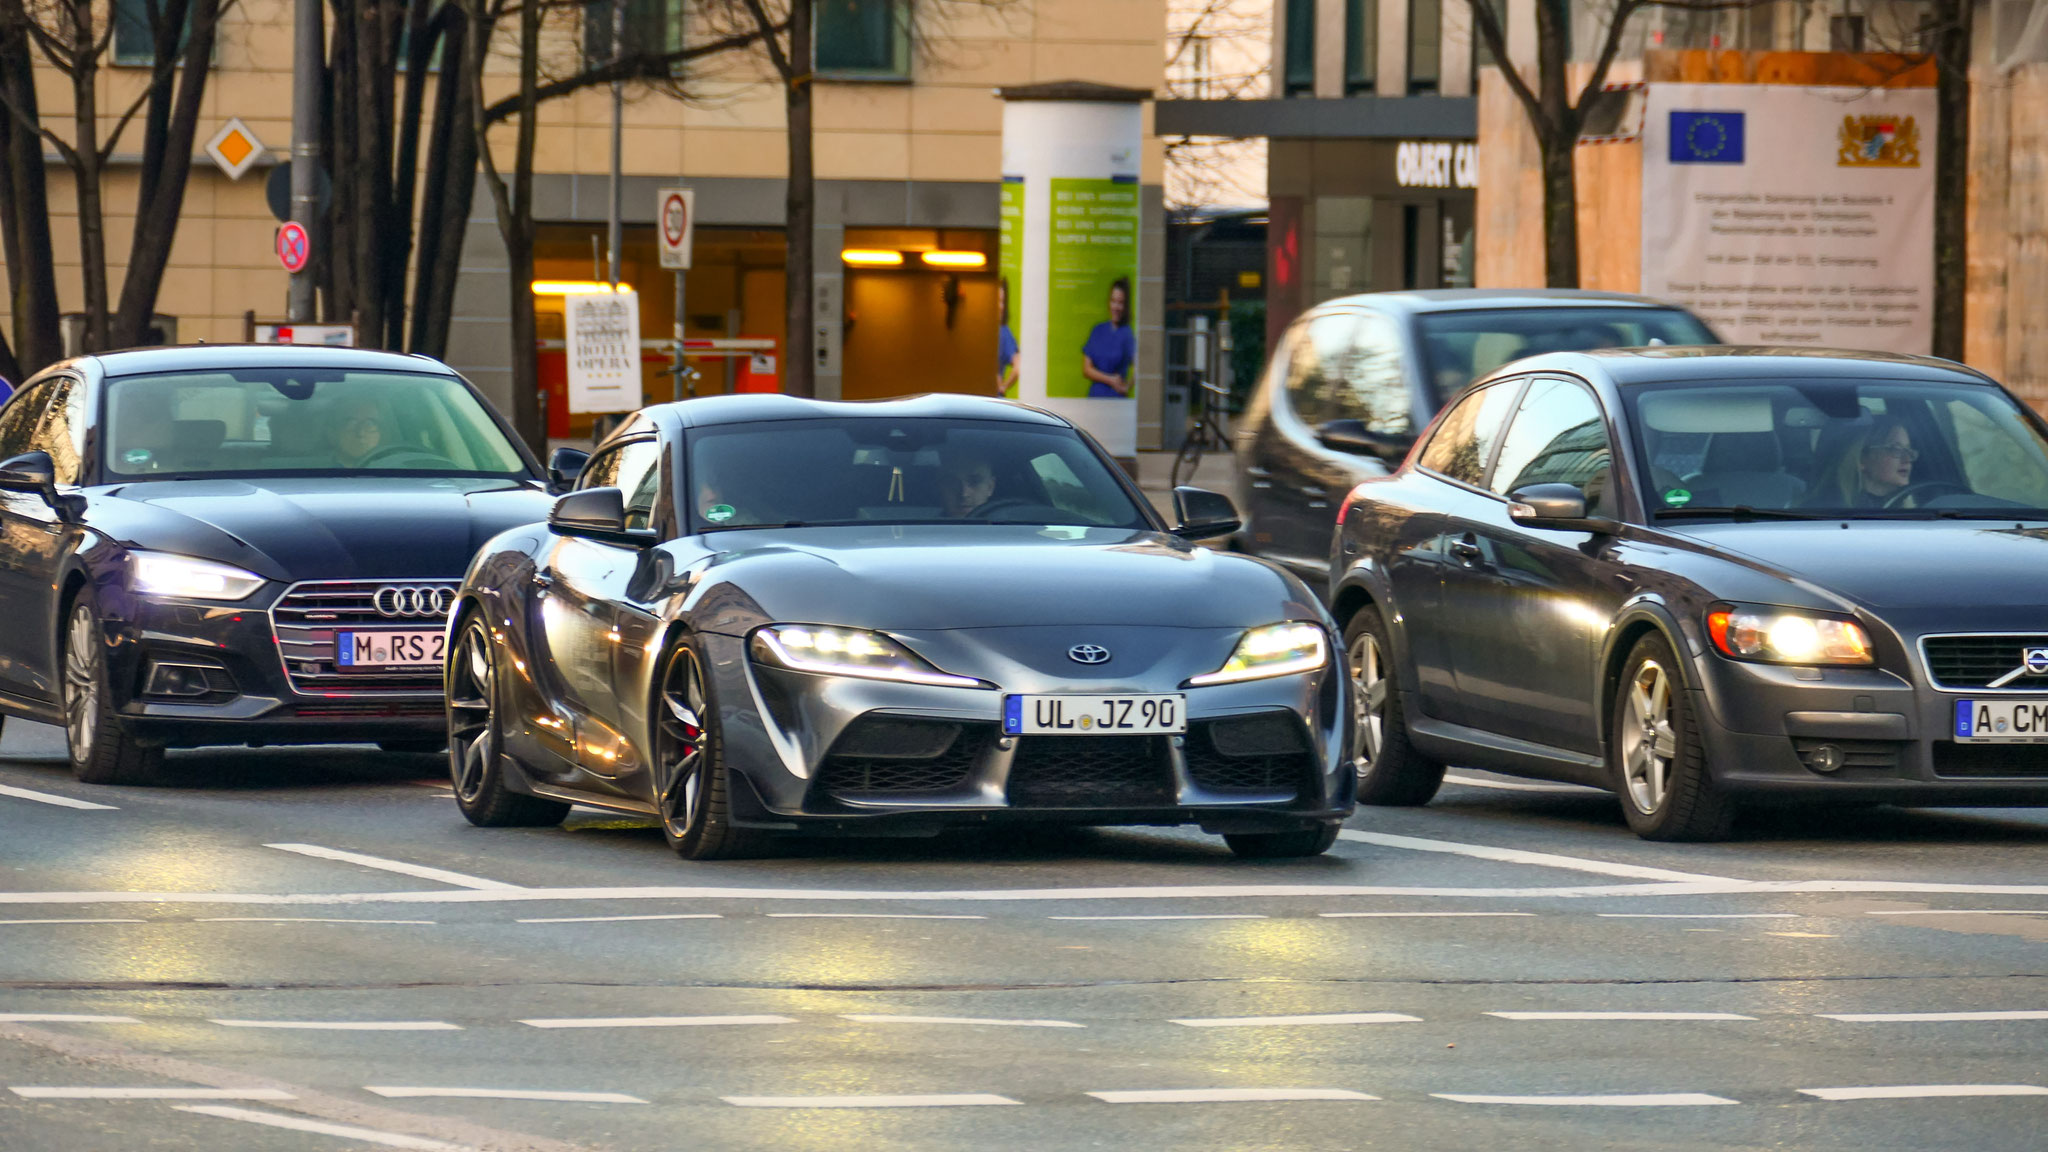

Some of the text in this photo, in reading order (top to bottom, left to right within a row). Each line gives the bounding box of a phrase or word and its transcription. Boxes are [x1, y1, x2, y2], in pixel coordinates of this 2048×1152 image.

[1397, 142, 1452, 188] OBJECT
[576, 343, 629, 357] HOTEL
[576, 357, 631, 370] OPERA
[355, 636, 372, 661] M
[391, 635, 425, 661] RS
[1036, 699, 1075, 729] UL
[1096, 699, 1135, 729] JZ
[1140, 698, 1175, 729] 90
[1975, 704, 1993, 733] A
